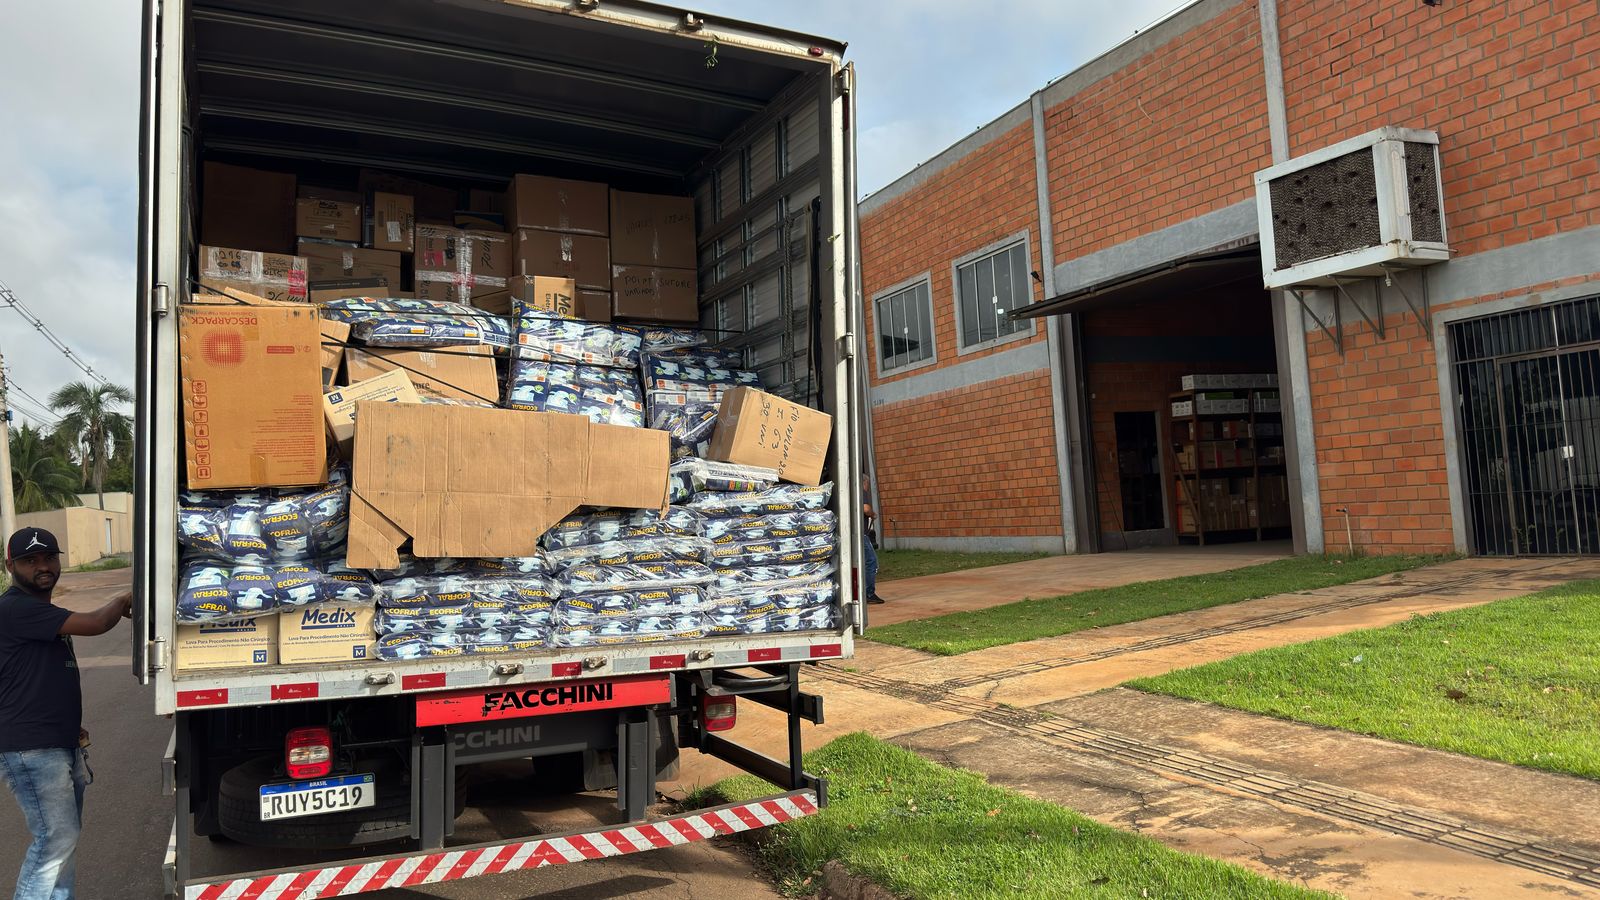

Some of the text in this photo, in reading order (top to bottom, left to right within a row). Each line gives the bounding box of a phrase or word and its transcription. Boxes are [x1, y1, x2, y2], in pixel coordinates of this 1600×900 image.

[191, 316, 258, 326] DESCARPACK
[301, 607, 356, 625] Medix
[355, 649, 364, 657] M
[484, 682, 613, 714] FACCHINI
[271, 786, 362, 816] RUY5C19
